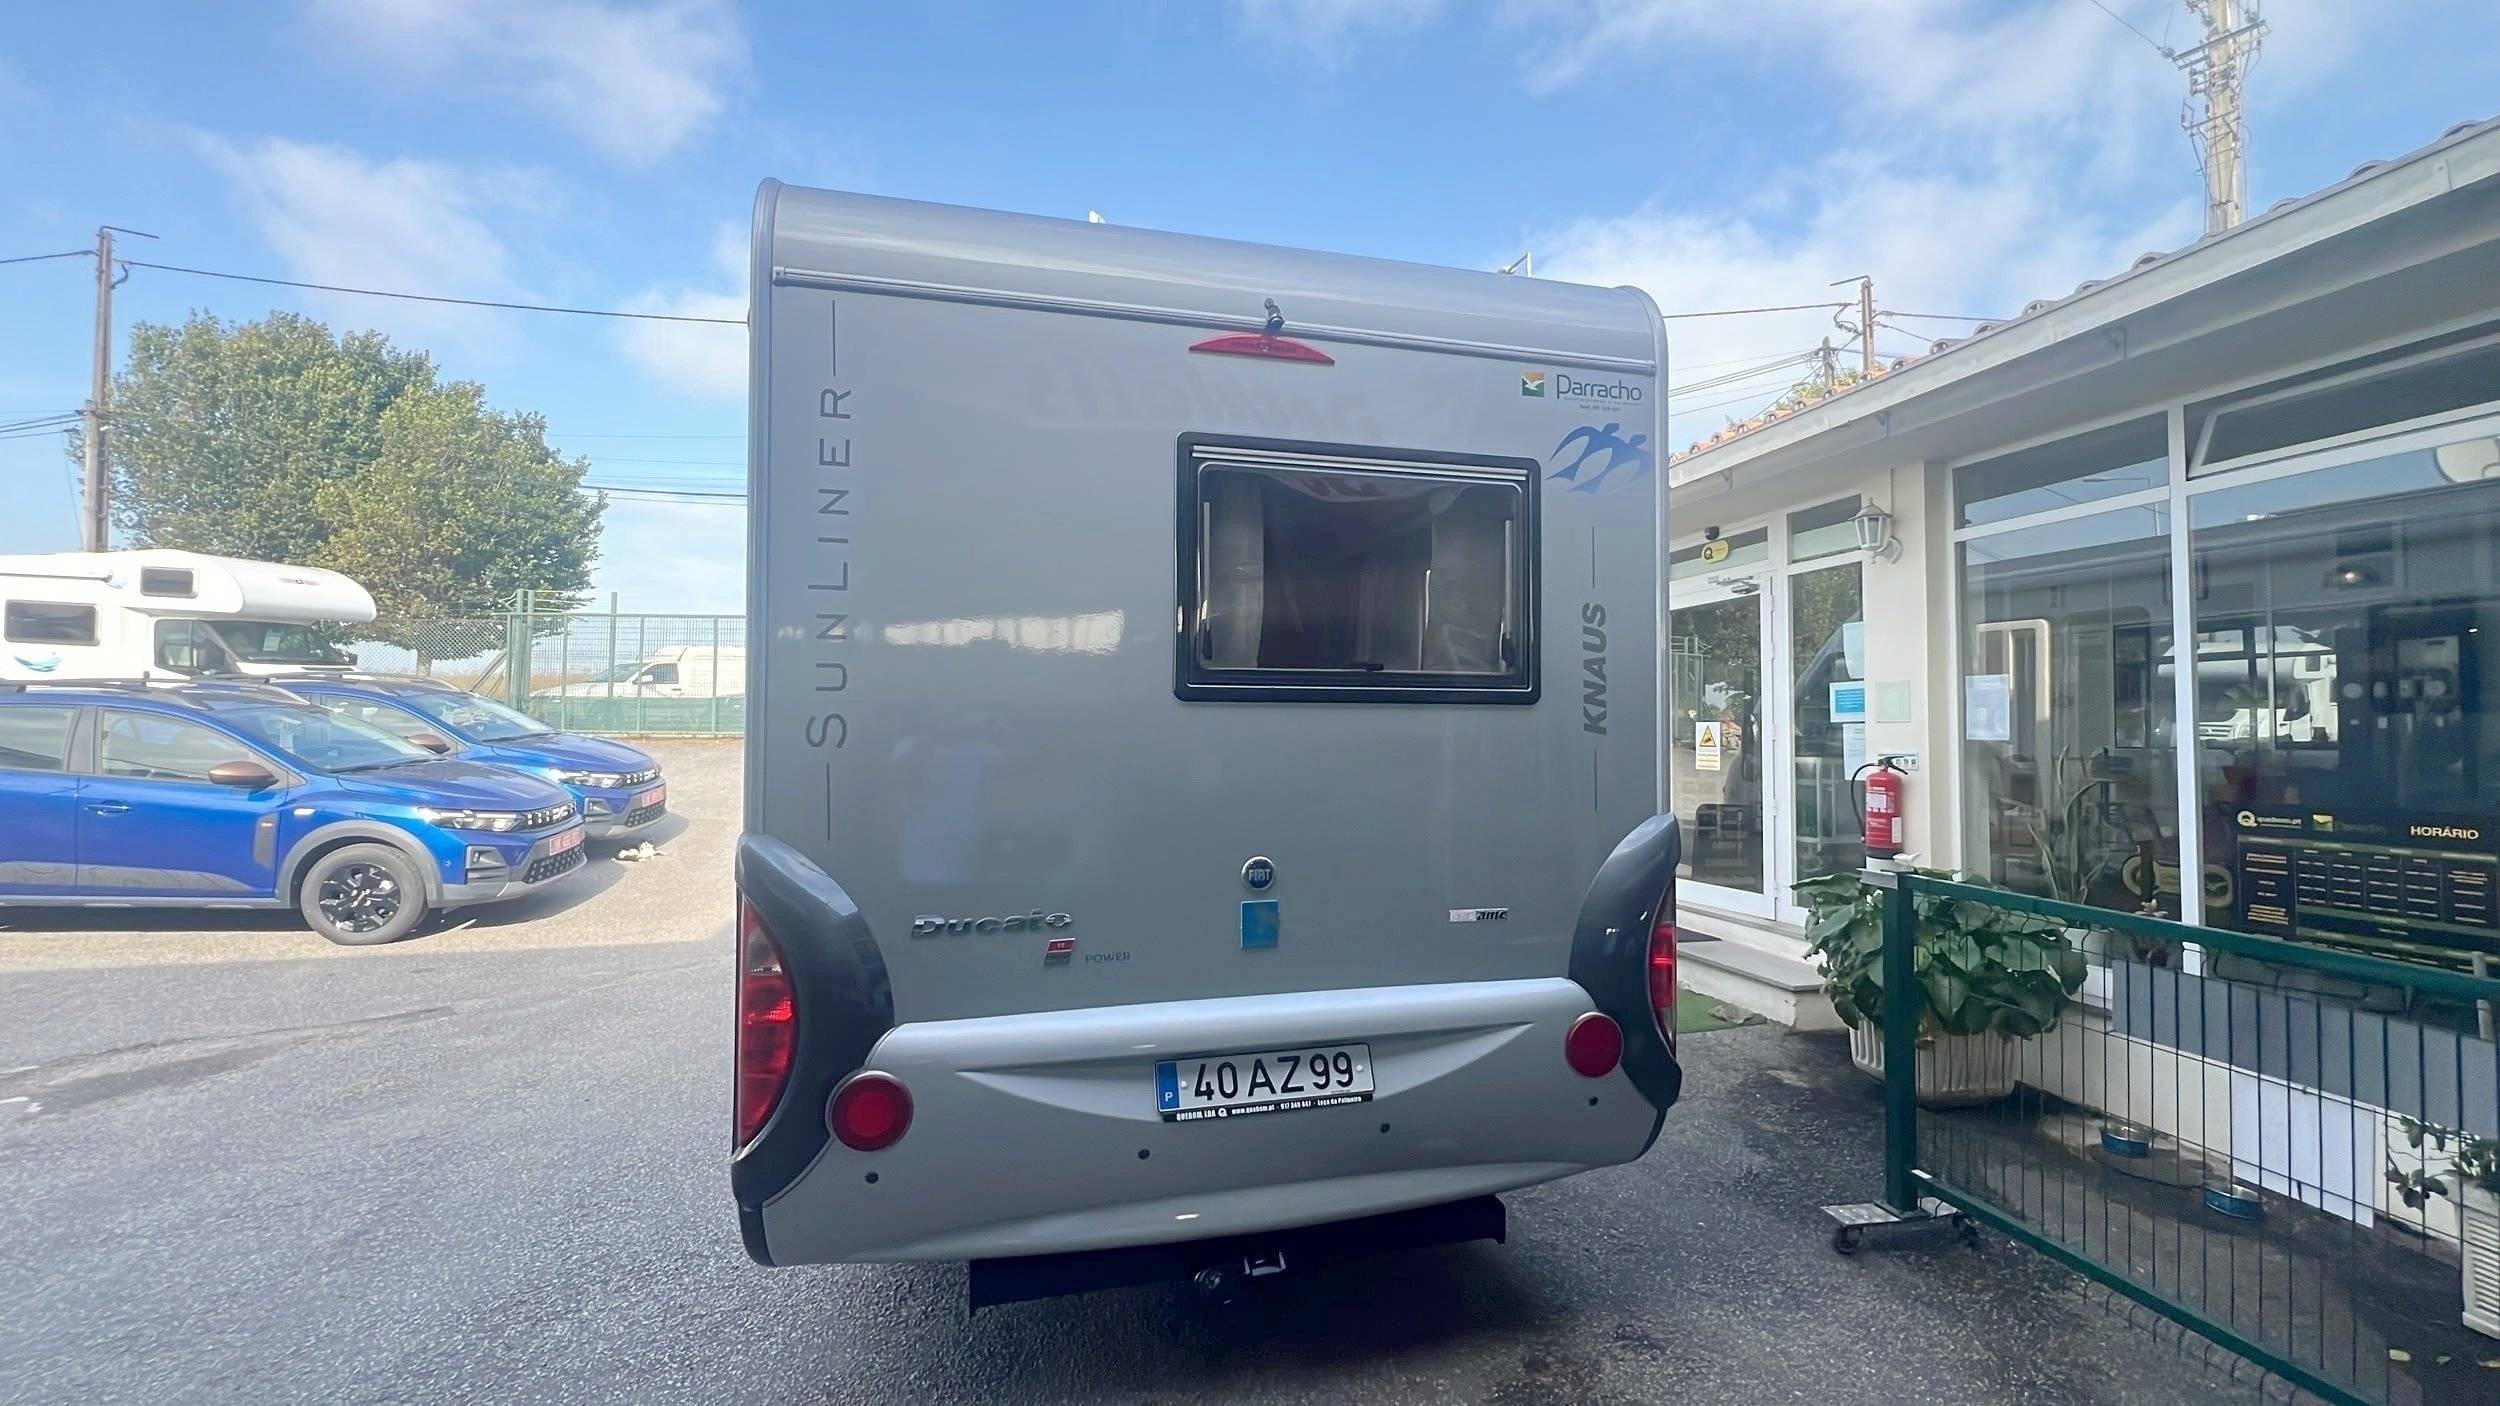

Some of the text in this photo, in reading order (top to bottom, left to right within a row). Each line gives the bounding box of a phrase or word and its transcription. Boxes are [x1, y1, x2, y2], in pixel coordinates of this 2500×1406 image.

[1556, 374, 1642, 401] Parracho
[805, 386, 852, 750] SUNLINER
[1582, 602, 1608, 736] KNAUS
[2410, 824, 2480, 840] HORÁRIO
[1248, 868, 1271, 881] FIAT
[912, 908, 1073, 937] Ducato
[1085, 951, 1131, 964] POWER
[1165, 1091, 1173, 1102] P
